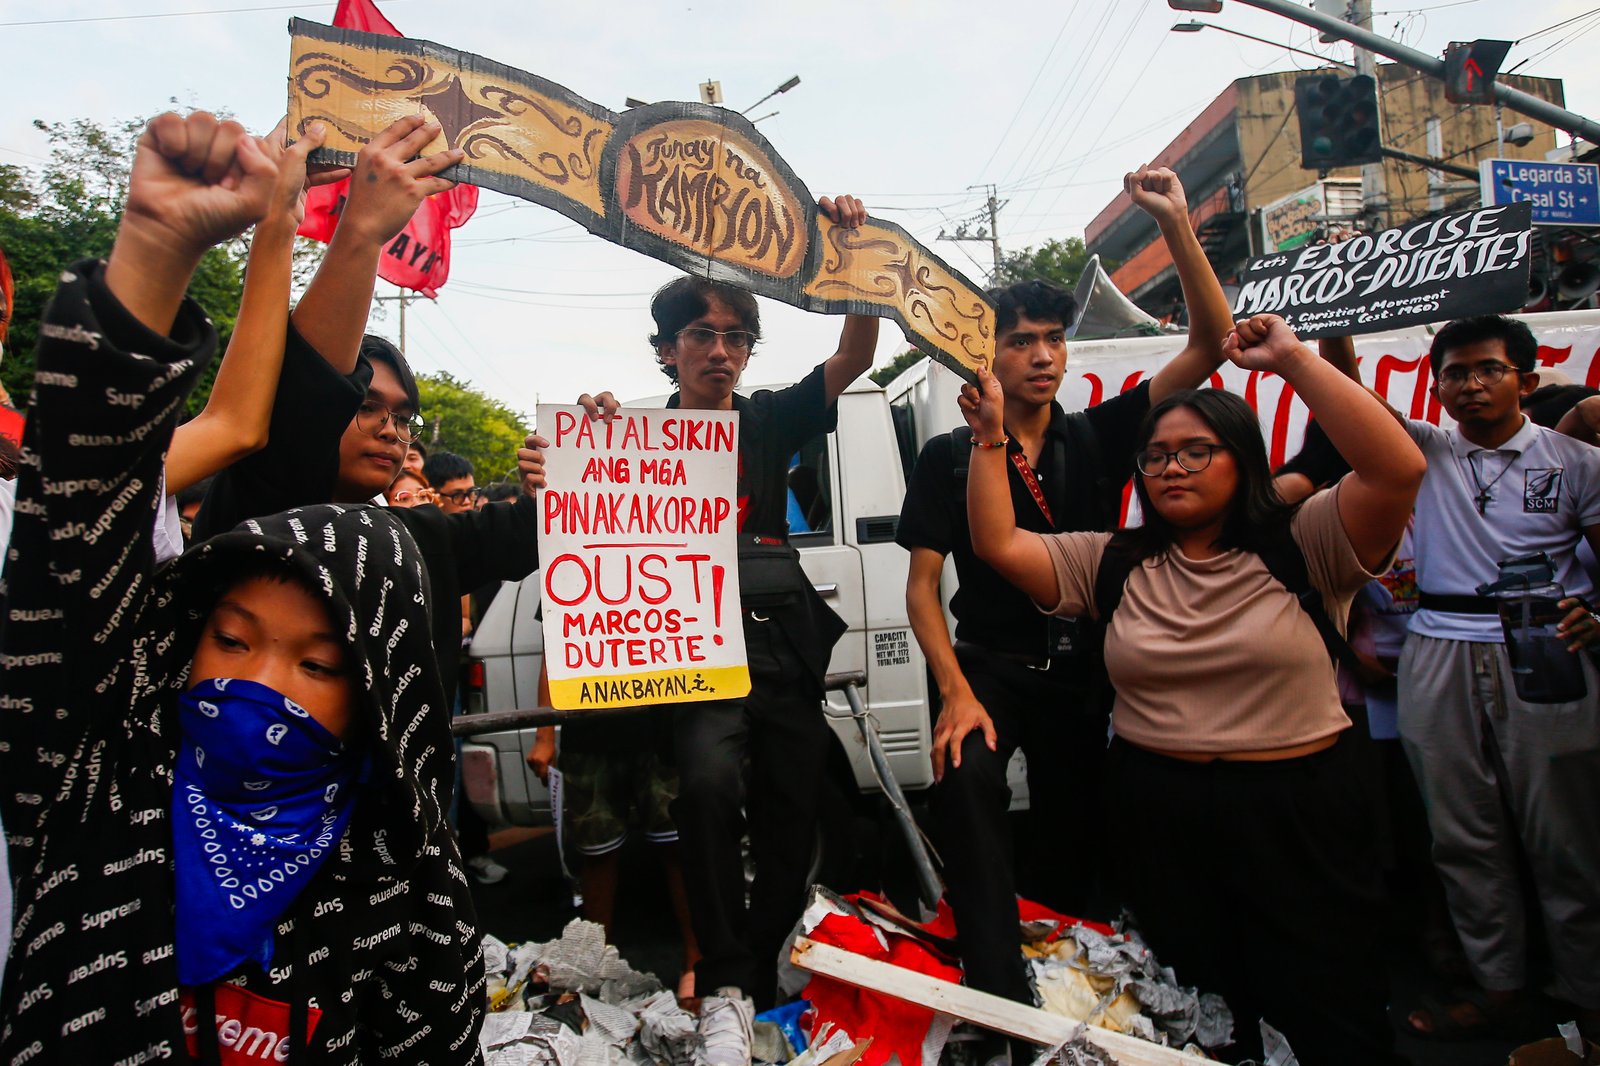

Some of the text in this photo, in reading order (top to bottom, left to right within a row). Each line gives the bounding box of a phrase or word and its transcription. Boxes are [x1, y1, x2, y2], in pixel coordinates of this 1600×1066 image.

[725, 149, 766, 188] na
[1508, 164, 1593, 187] Legarda St
[625, 143, 795, 273] KAMPYON
[1558, 190, 1575, 208] St
[1291, 206, 1507, 272] EXORCISE
[1298, 306, 1366, 322] Christian
[1371, 289, 1450, 311] Movement
[555, 411, 734, 453] PATALSIKIN
[582, 457, 687, 486] ANG MGA
[82, 478, 143, 546] Supreme
[544, 489, 731, 535] PINAKAKORAP
[1527, 499, 1555, 509] SCM
[93, 572, 143, 645] Supreme
[563, 608, 698, 638] MARCOS-
[565, 635, 706, 669] DUTERTE
[874, 631, 908, 643] CAPACITY
[103, 848, 166, 877] Supreme
[379, 1024, 432, 1060] Supreme
